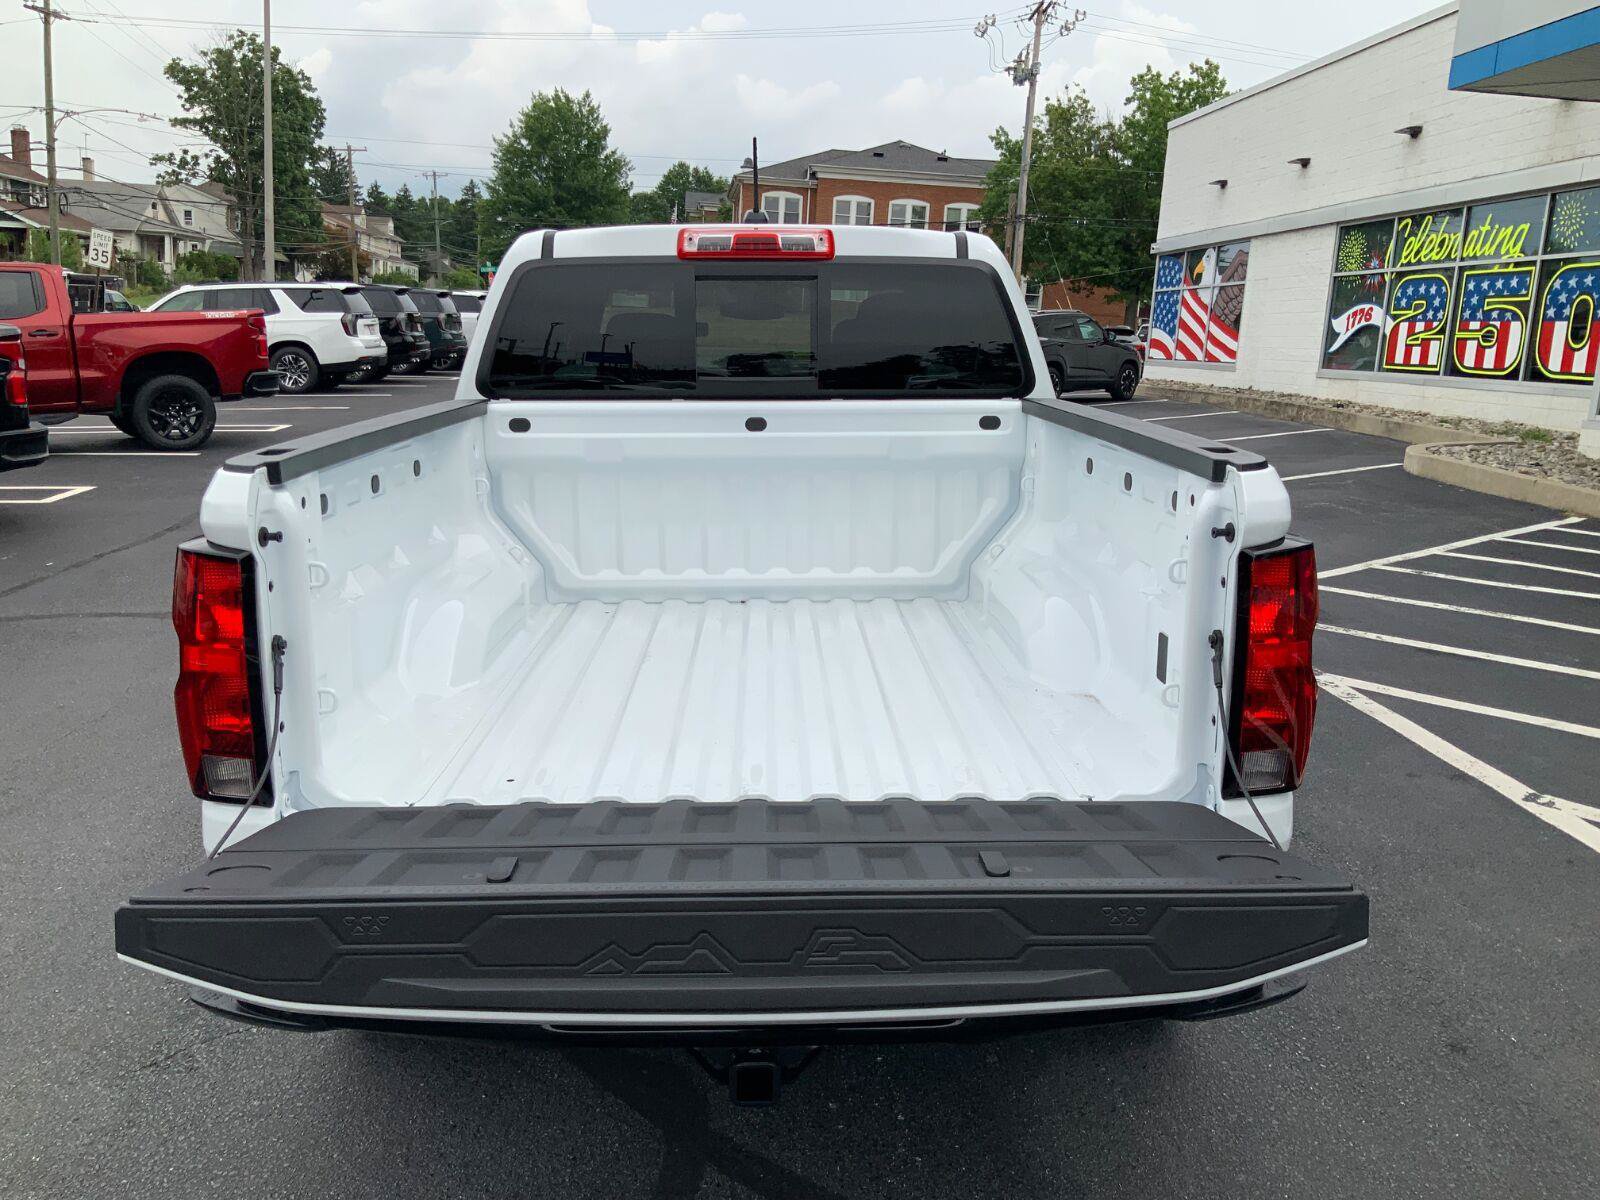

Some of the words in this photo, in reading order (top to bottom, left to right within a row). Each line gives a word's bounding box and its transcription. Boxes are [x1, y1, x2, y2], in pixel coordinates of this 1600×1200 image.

[93, 232, 111, 242] SPEED
[93, 241, 109, 249] LIMIT
[1384, 213, 1531, 280] Celebrating
[91, 248, 109, 264] 35
[1345, 306, 1374, 335] 1776
[1383, 261, 1600, 381] 250
